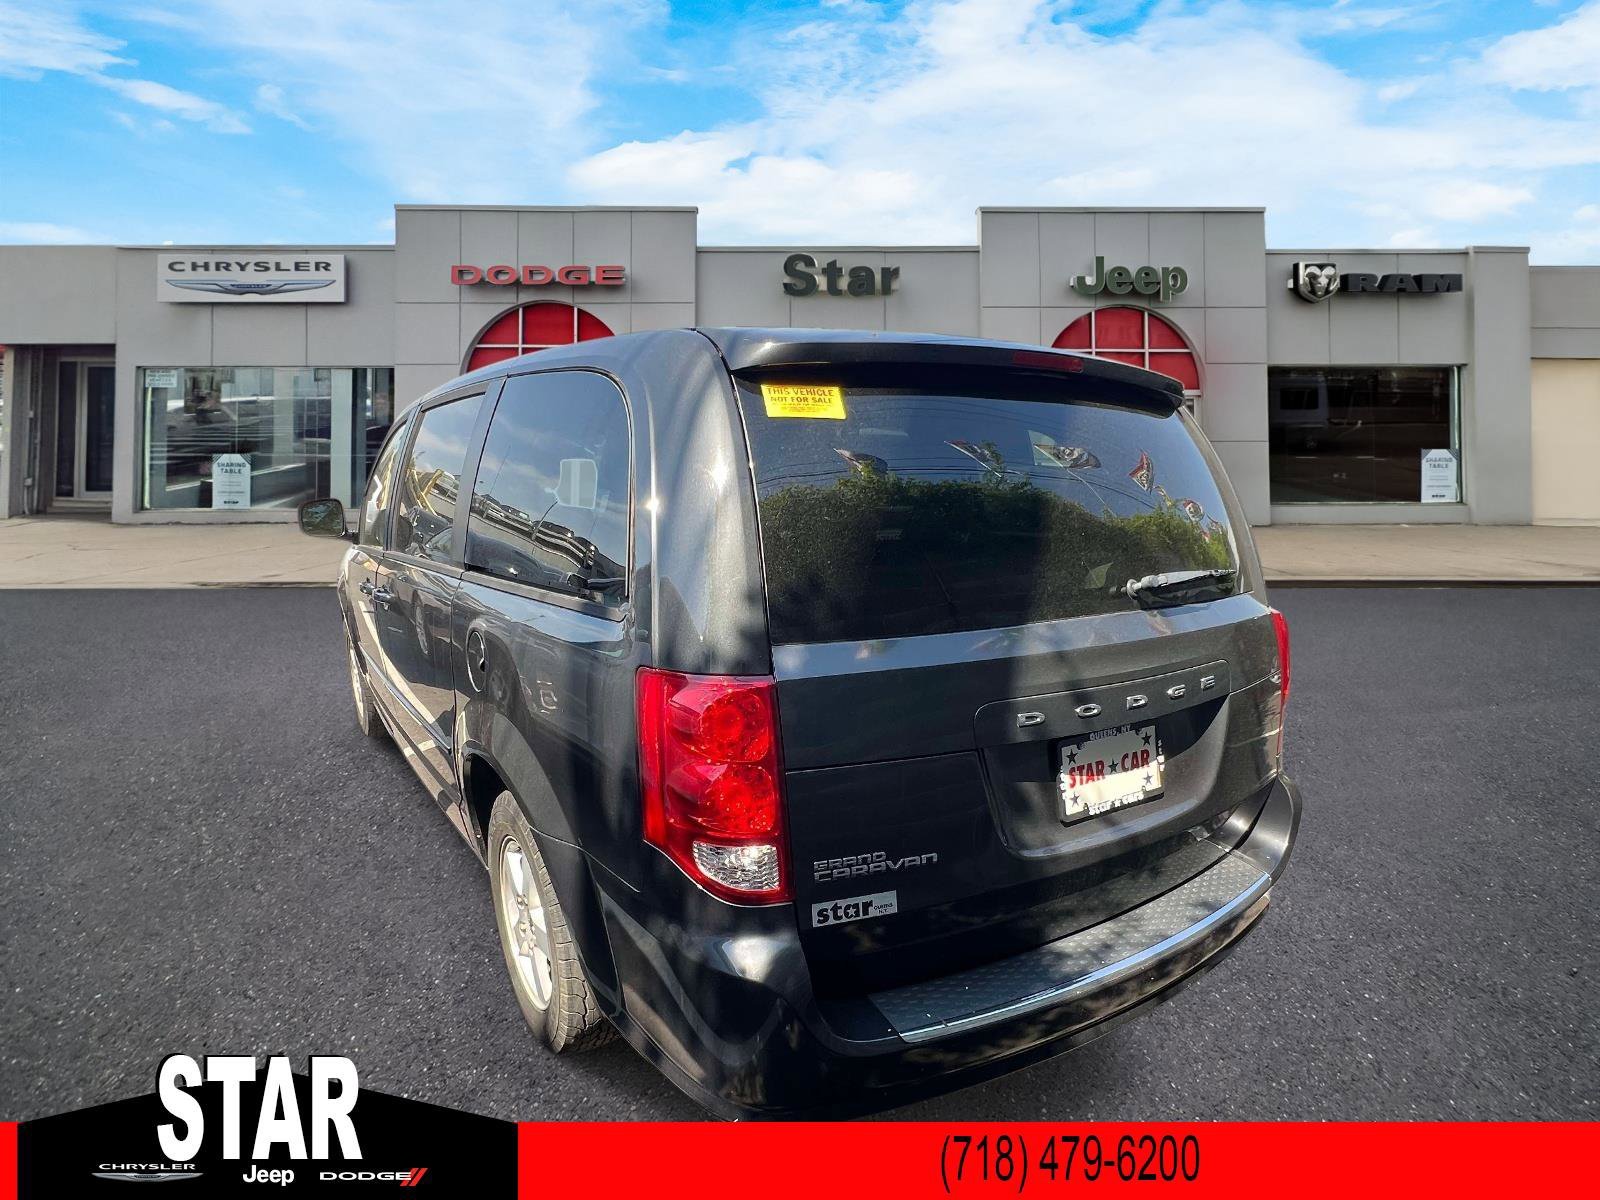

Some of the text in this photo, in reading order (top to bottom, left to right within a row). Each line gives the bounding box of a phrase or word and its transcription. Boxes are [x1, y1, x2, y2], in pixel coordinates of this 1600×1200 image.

[167, 261, 333, 272] CHRYSLER
[450, 265, 626, 286] DODGE
[783, 253, 900, 297] Star
[1070, 256, 1188, 303] Jeep
[1342, 273, 1463, 292] RAM
[767, 387, 834, 397] THIS VEHICLE
[811, 396, 832, 404] SALE
[1016, 675, 1215, 728] DODGE
[1069, 761, 1105, 789] STAR
[1121, 748, 1150, 772] CAR
[813, 851, 887, 871] GRAND
[816, 899, 873, 924] star
